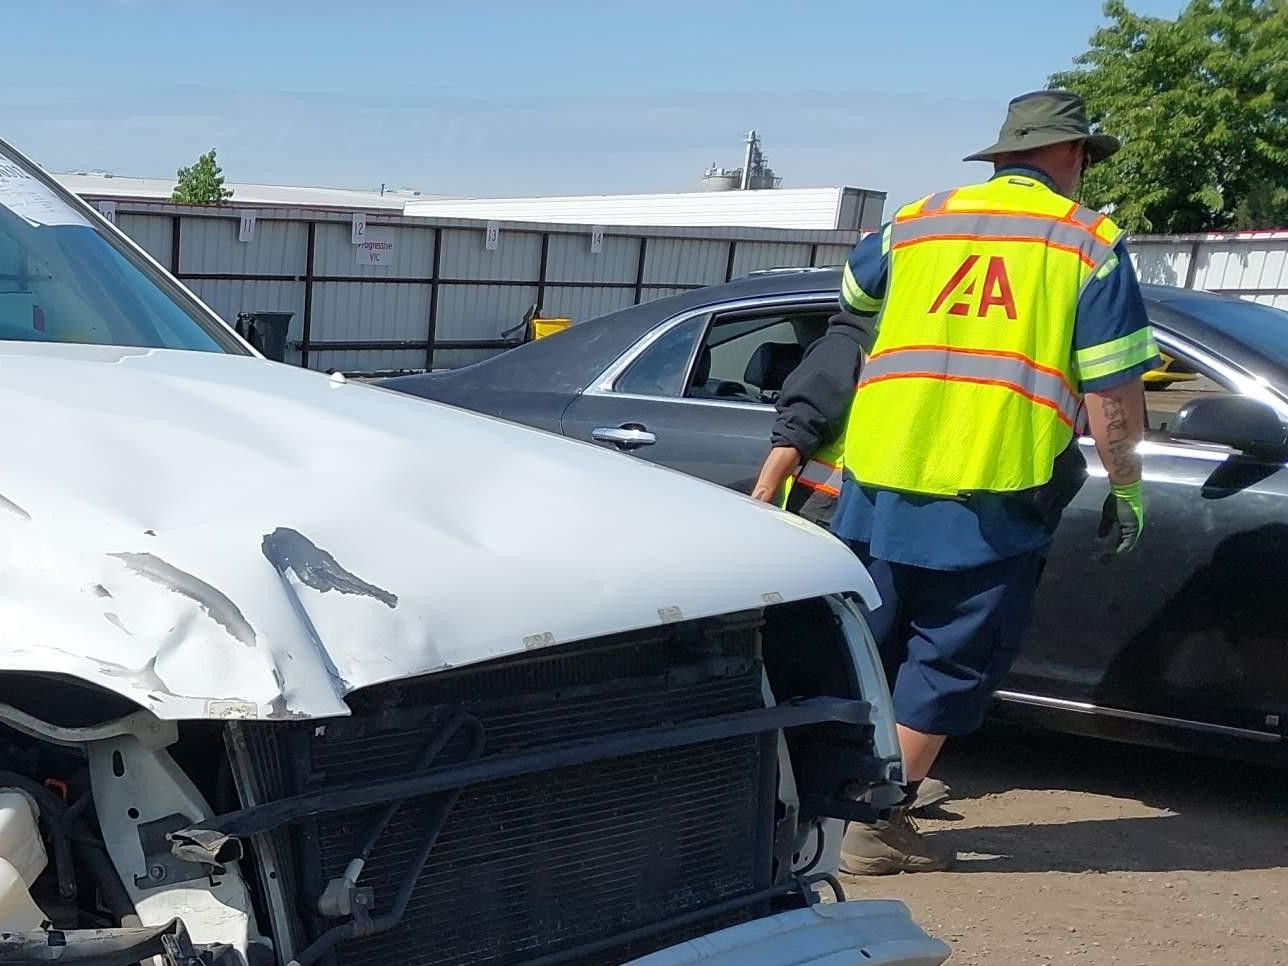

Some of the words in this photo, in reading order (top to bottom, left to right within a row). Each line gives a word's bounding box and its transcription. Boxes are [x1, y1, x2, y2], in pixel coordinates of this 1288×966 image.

[243, 217, 252, 233] 11
[354, 221, 364, 236] 12
[487, 229, 497, 243] 13
[593, 232, 602, 245] 14
